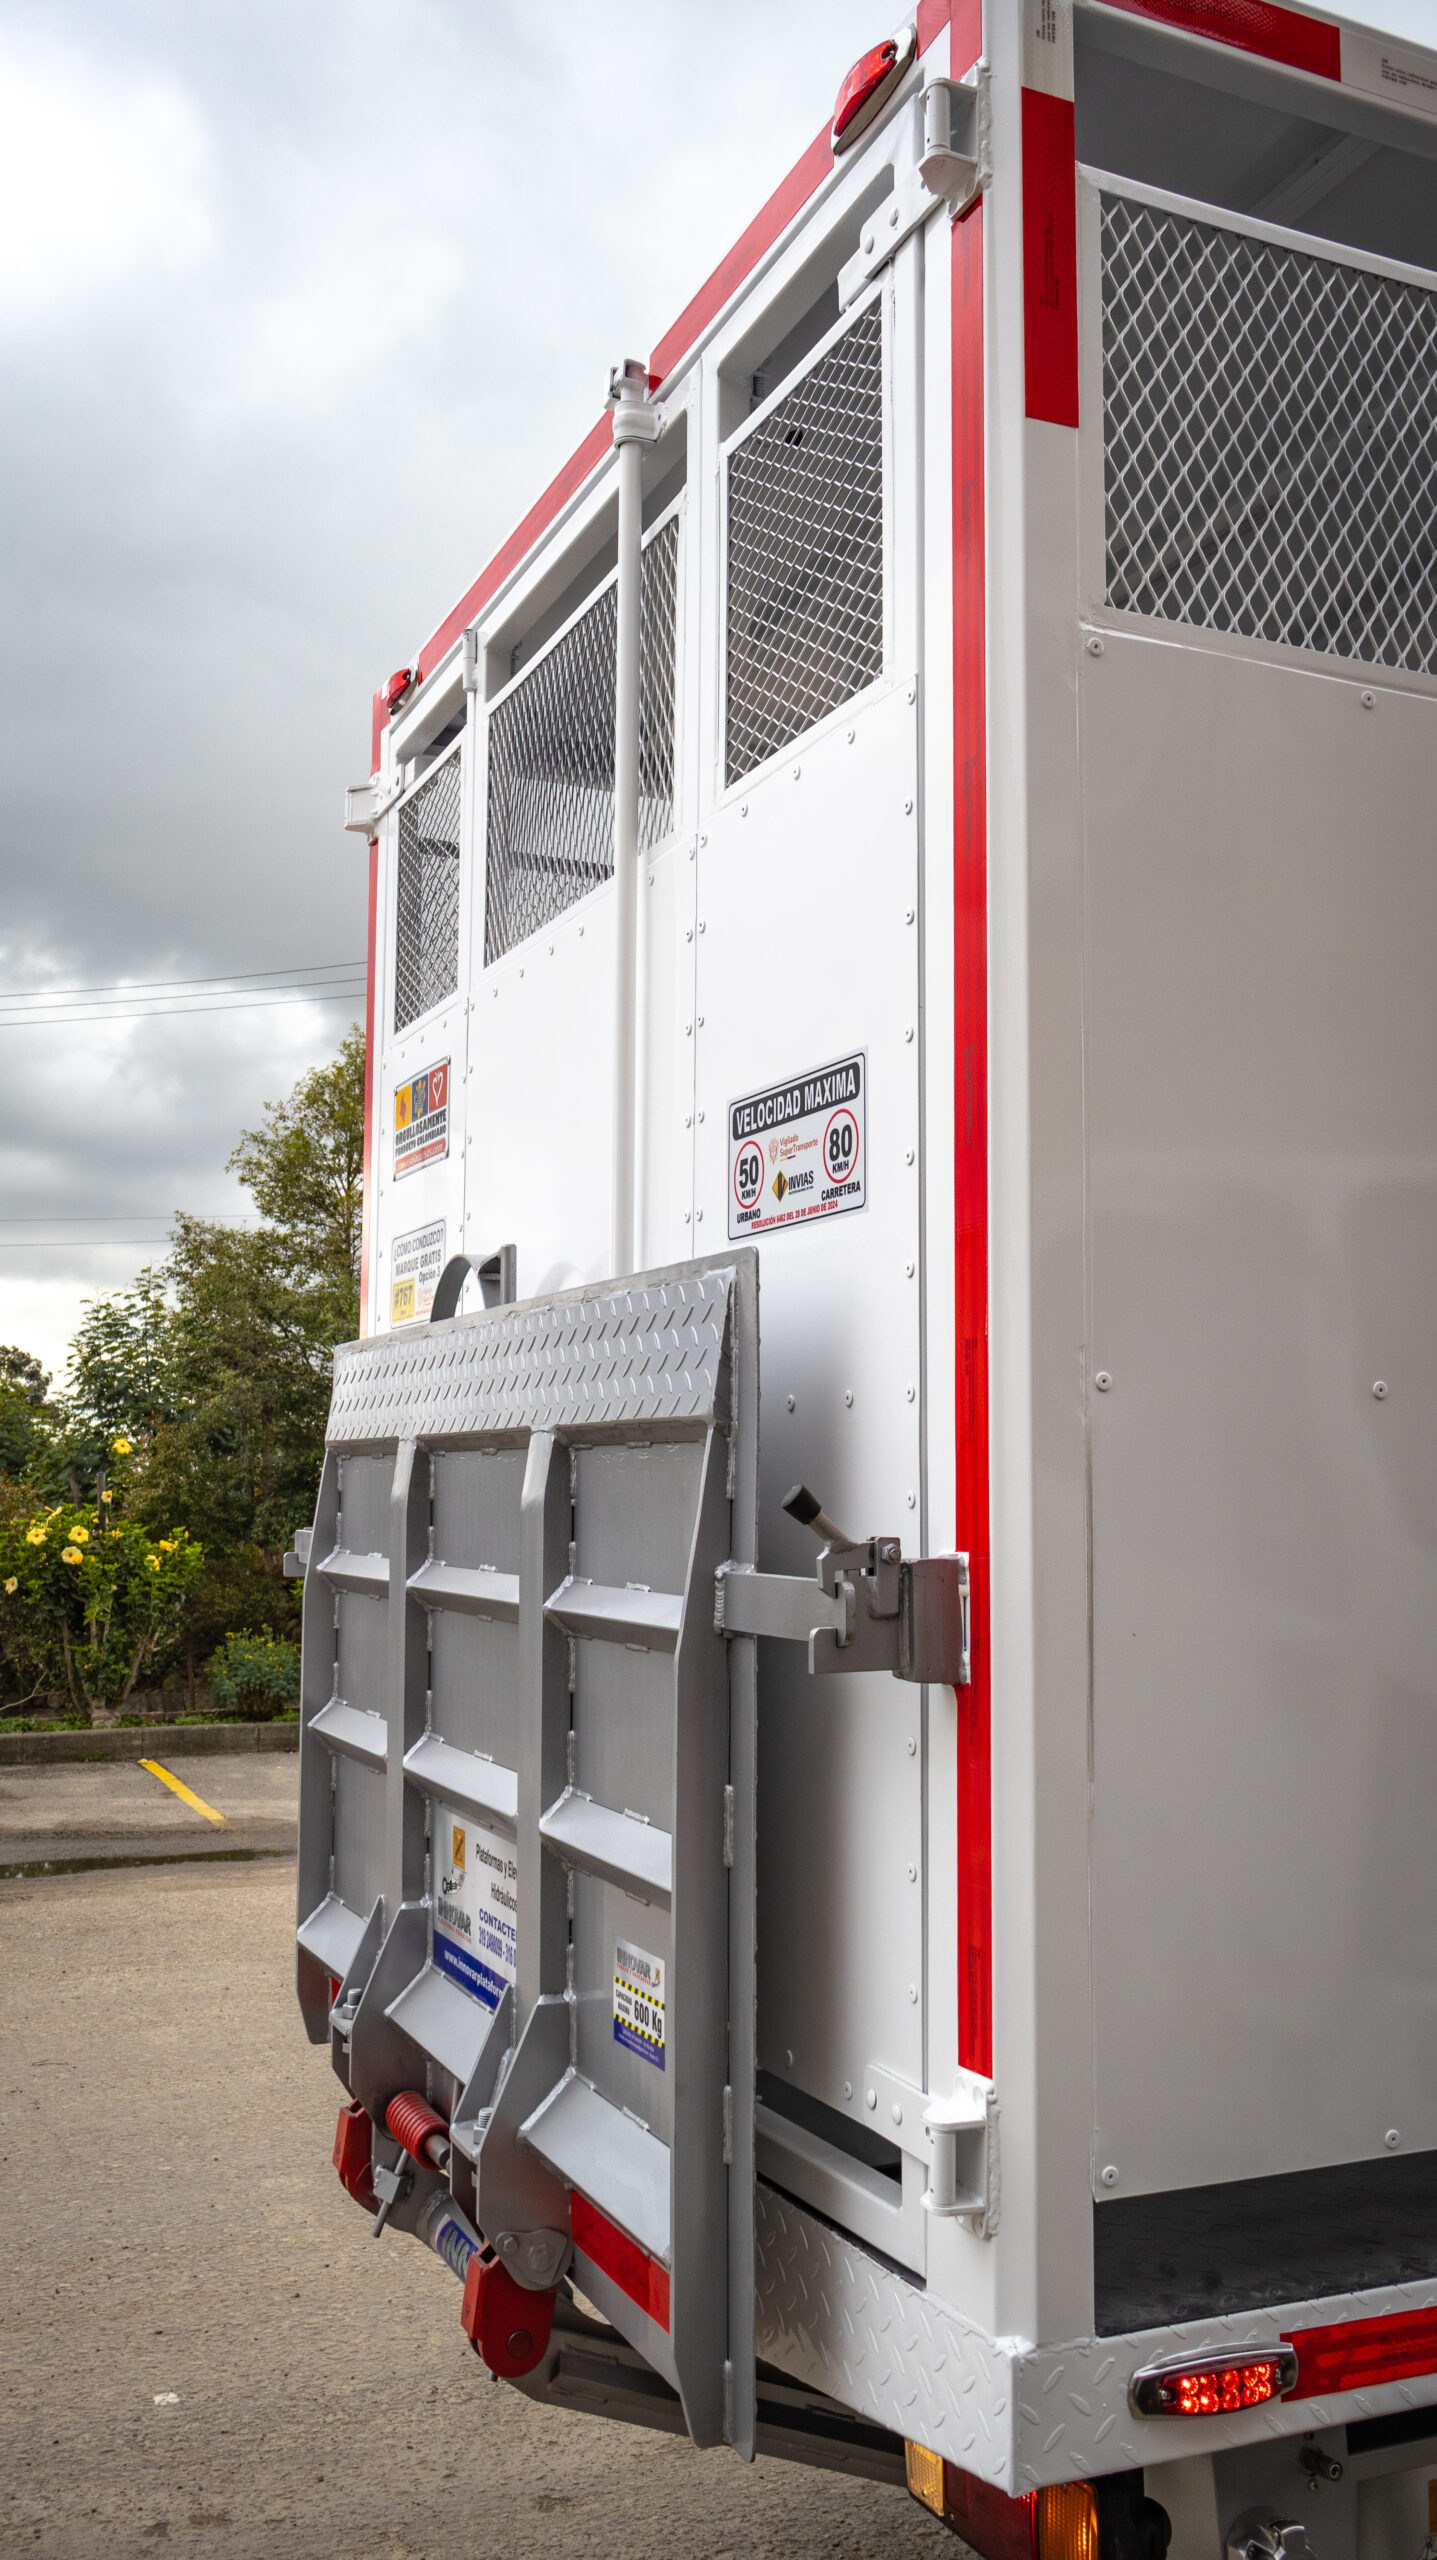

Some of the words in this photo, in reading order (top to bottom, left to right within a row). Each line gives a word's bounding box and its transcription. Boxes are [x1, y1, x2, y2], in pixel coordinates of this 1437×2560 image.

[736, 1088, 800, 1135] VELOCIDAD
[804, 1068, 856, 1112] MAXIMA
[395, 1108, 446, 1146] ORGULLOSAMENTE
[417, 1124, 446, 1146] COLOMBIANO
[829, 1124, 852, 1162] 80
[738, 1154, 759, 1189] 50
[832, 1160, 849, 1174] KM/H
[788, 1170, 814, 1191] INVIAS
[822, 1181, 861, 1201] CARRETERA
[742, 1188, 756, 1200] KM/H
[736, 1208, 761, 1224] URBANO
[412, 1228, 444, 1252] CONDUZCO?
[395, 1256, 419, 1276] MARQUE
[420, 1248, 442, 1268] GRATIS
[394, 1284, 413, 1309] #767
[476, 1843, 504, 1874] Plataformas
[478, 1908, 516, 1942] CONTACTE
[634, 2000, 649, 2027] 600
[652, 2010, 662, 2040] Kg
